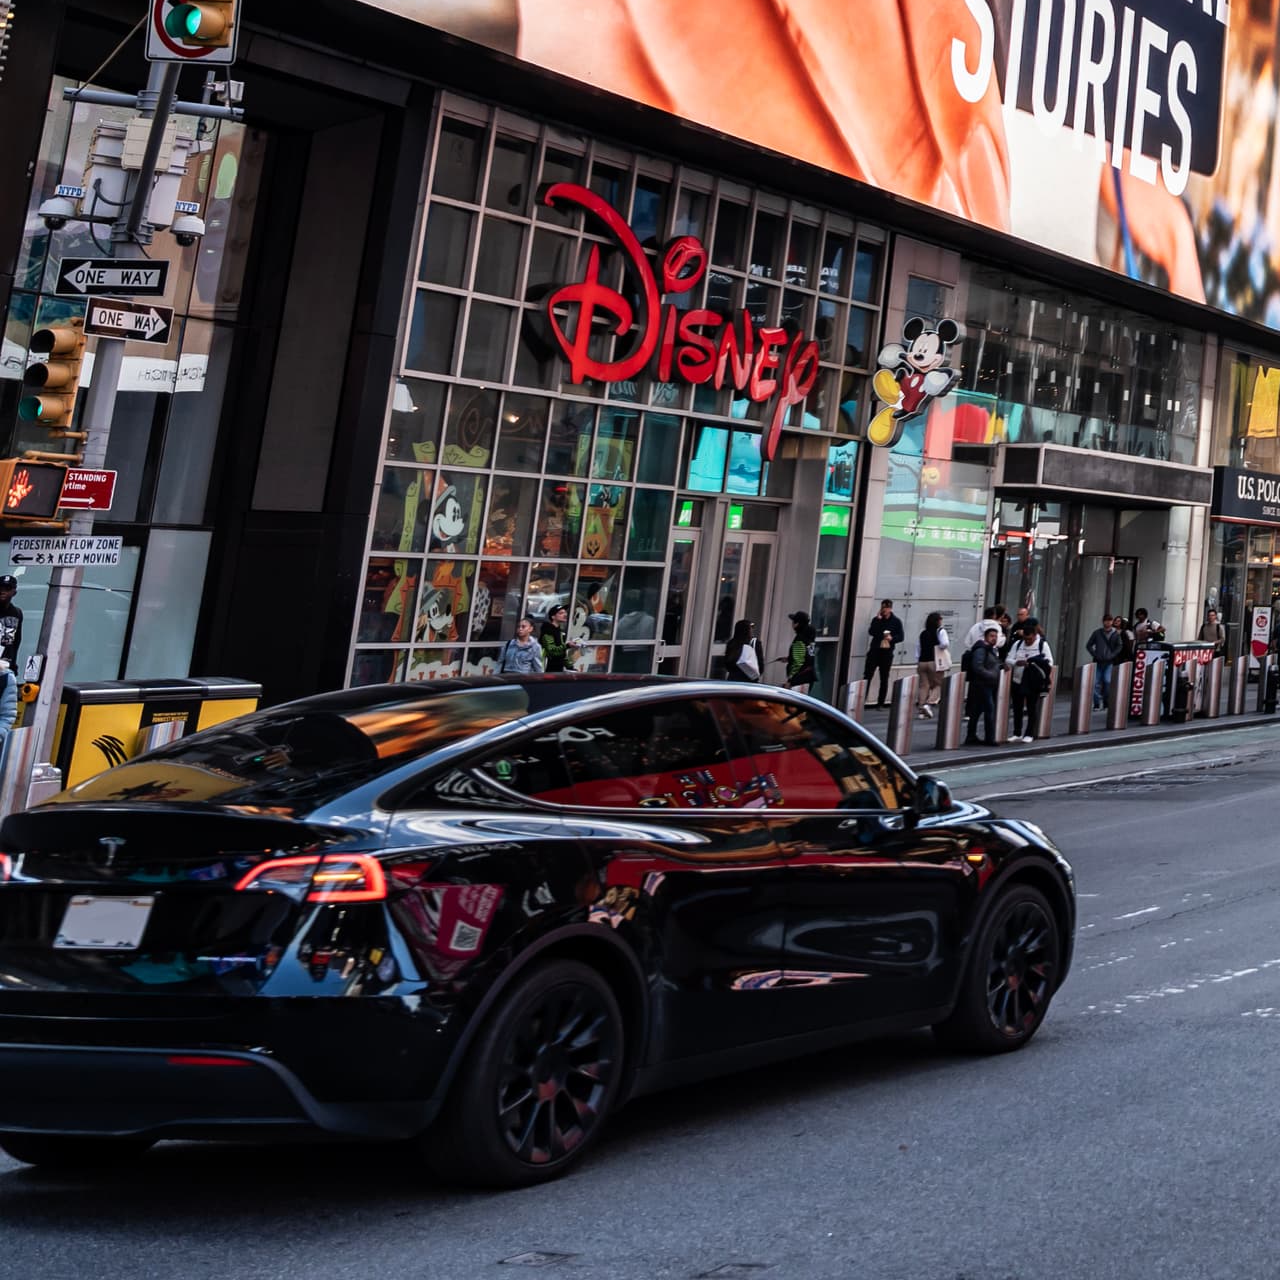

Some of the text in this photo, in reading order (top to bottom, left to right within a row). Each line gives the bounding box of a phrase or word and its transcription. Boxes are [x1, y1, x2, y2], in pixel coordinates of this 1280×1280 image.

[57, 185, 82, 197] NYPD
[176, 201, 198, 212] NYPD
[75, 270, 154, 285] ONE WAY
[99, 310, 161, 331] ONE WAY
[68, 472, 107, 483] STANDING
[1237, 475, 1255, 500] U.S.
[12, 538, 120, 551] PEDESTRIAN FLOW ZONE
[58, 553, 118, 565] KEEP MOVING
